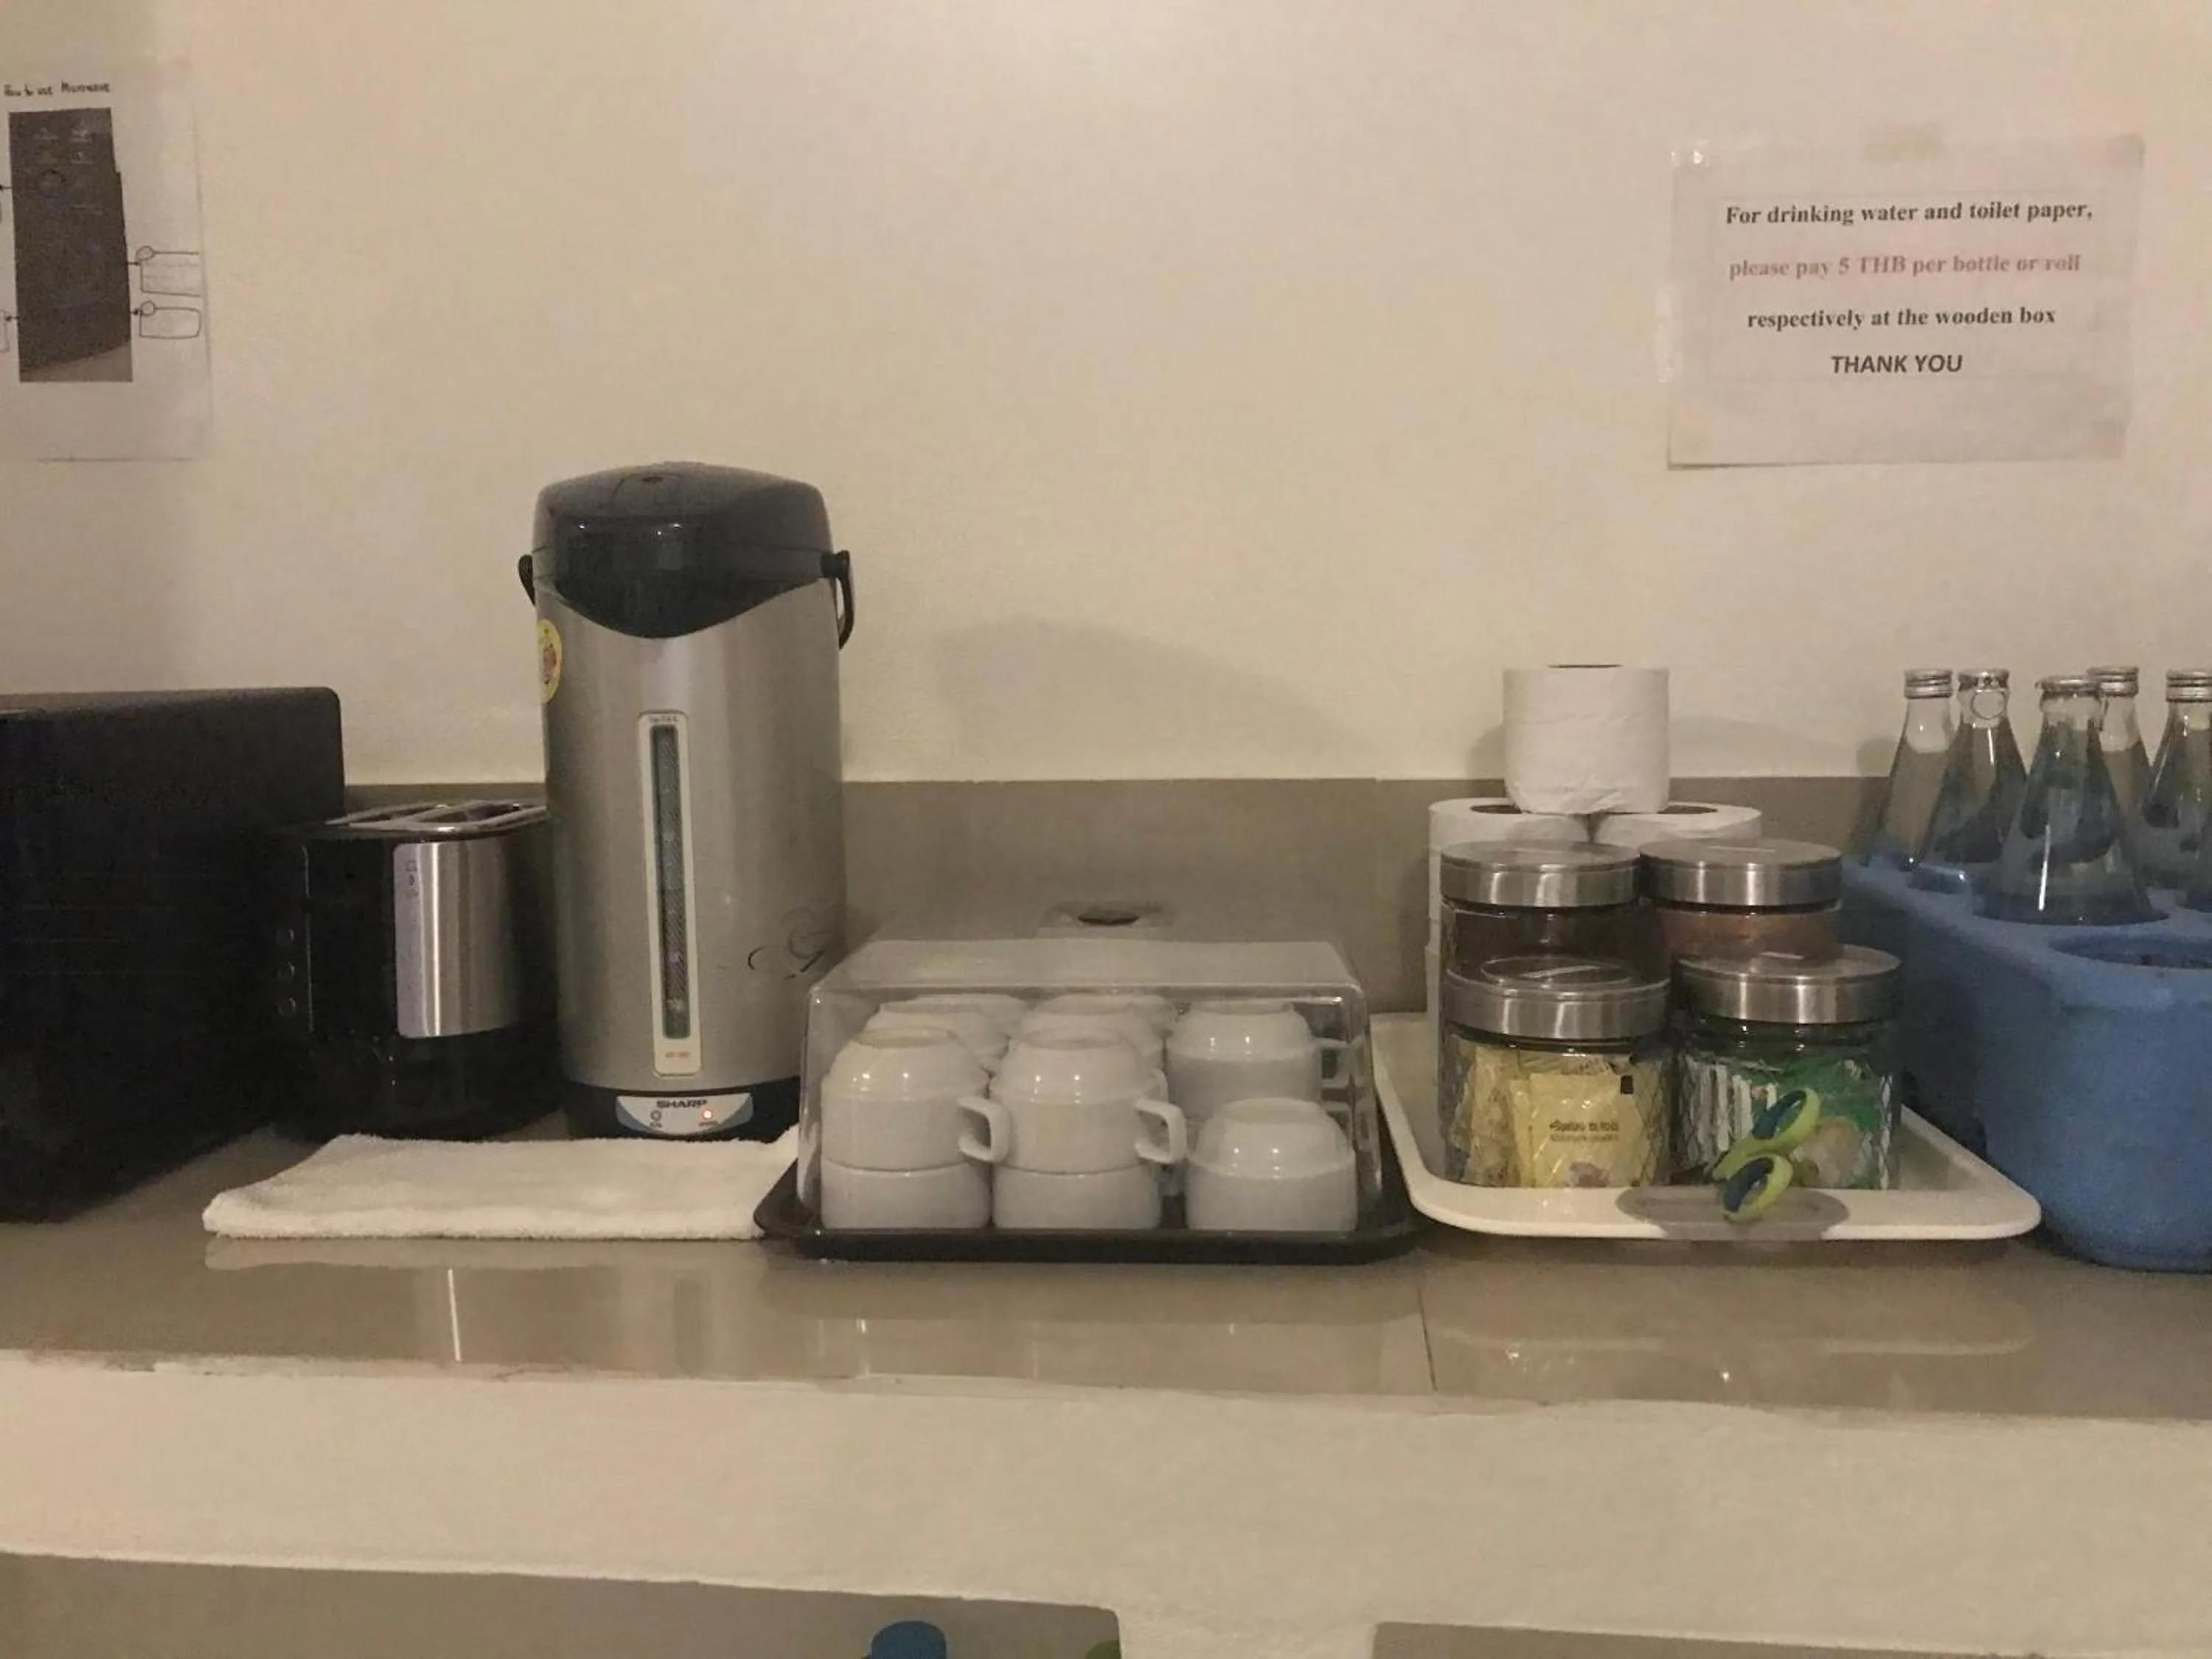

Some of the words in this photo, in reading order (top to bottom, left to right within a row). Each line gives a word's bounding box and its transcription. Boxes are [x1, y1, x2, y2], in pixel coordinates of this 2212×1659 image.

[1726, 206, 1762, 225] For
[1767, 203, 1855, 226] drinking
[1860, 204, 1919, 222] water
[1924, 201, 1963, 221] and
[1969, 201, 2020, 220] toilet
[2026, 203, 2093, 223] paper,
[1729, 258, 1790, 280] please
[1795, 261, 1829, 280] pay
[1837, 256, 1851, 276] 5
[1859, 254, 1907, 275] THB
[1912, 259, 1947, 278] per
[1952, 254, 2011, 273] bottle
[2016, 258, 2040, 272] or
[2045, 253, 2081, 272] roll
[1747, 307, 1865, 332] respectively
[1871, 310, 1891, 327] at
[1896, 307, 1930, 326] the
[1935, 306, 2014, 326] wooden
[2020, 305, 2056, 324] box
[1830, 355, 1908, 375] THANK
[1914, 354, 1964, 373] YOU
[656, 1099, 708, 1109] SHARP
